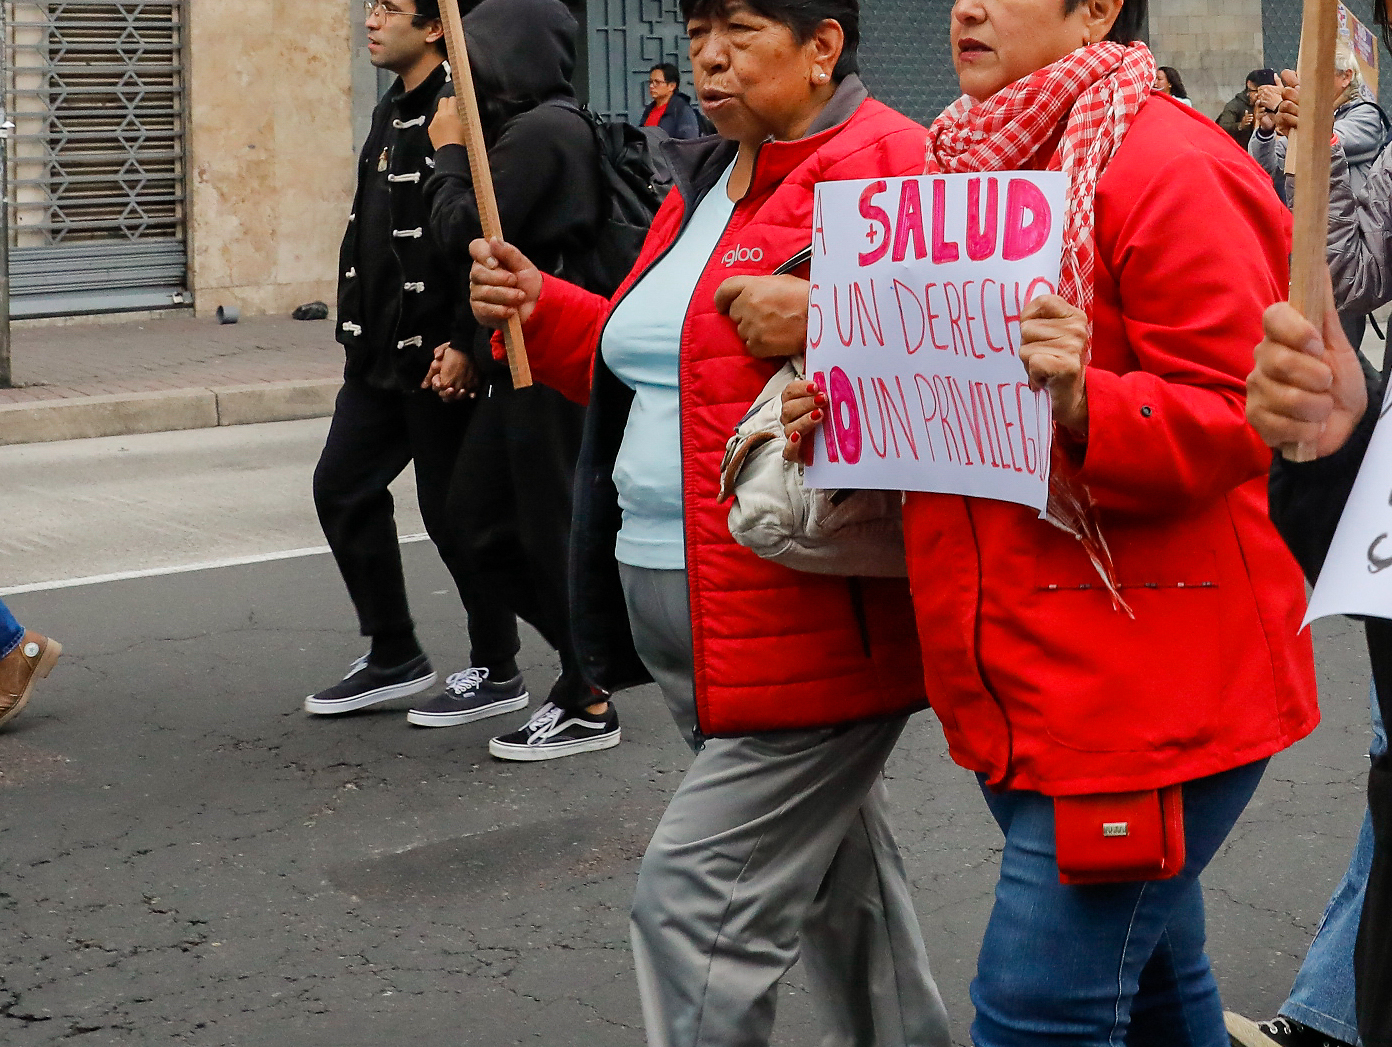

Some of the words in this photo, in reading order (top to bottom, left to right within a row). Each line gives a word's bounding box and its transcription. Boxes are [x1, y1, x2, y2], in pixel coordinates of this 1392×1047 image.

[857, 177, 1052, 267] SALUD
[833, 277, 885, 348] UN
[857, 374, 920, 462] UN
